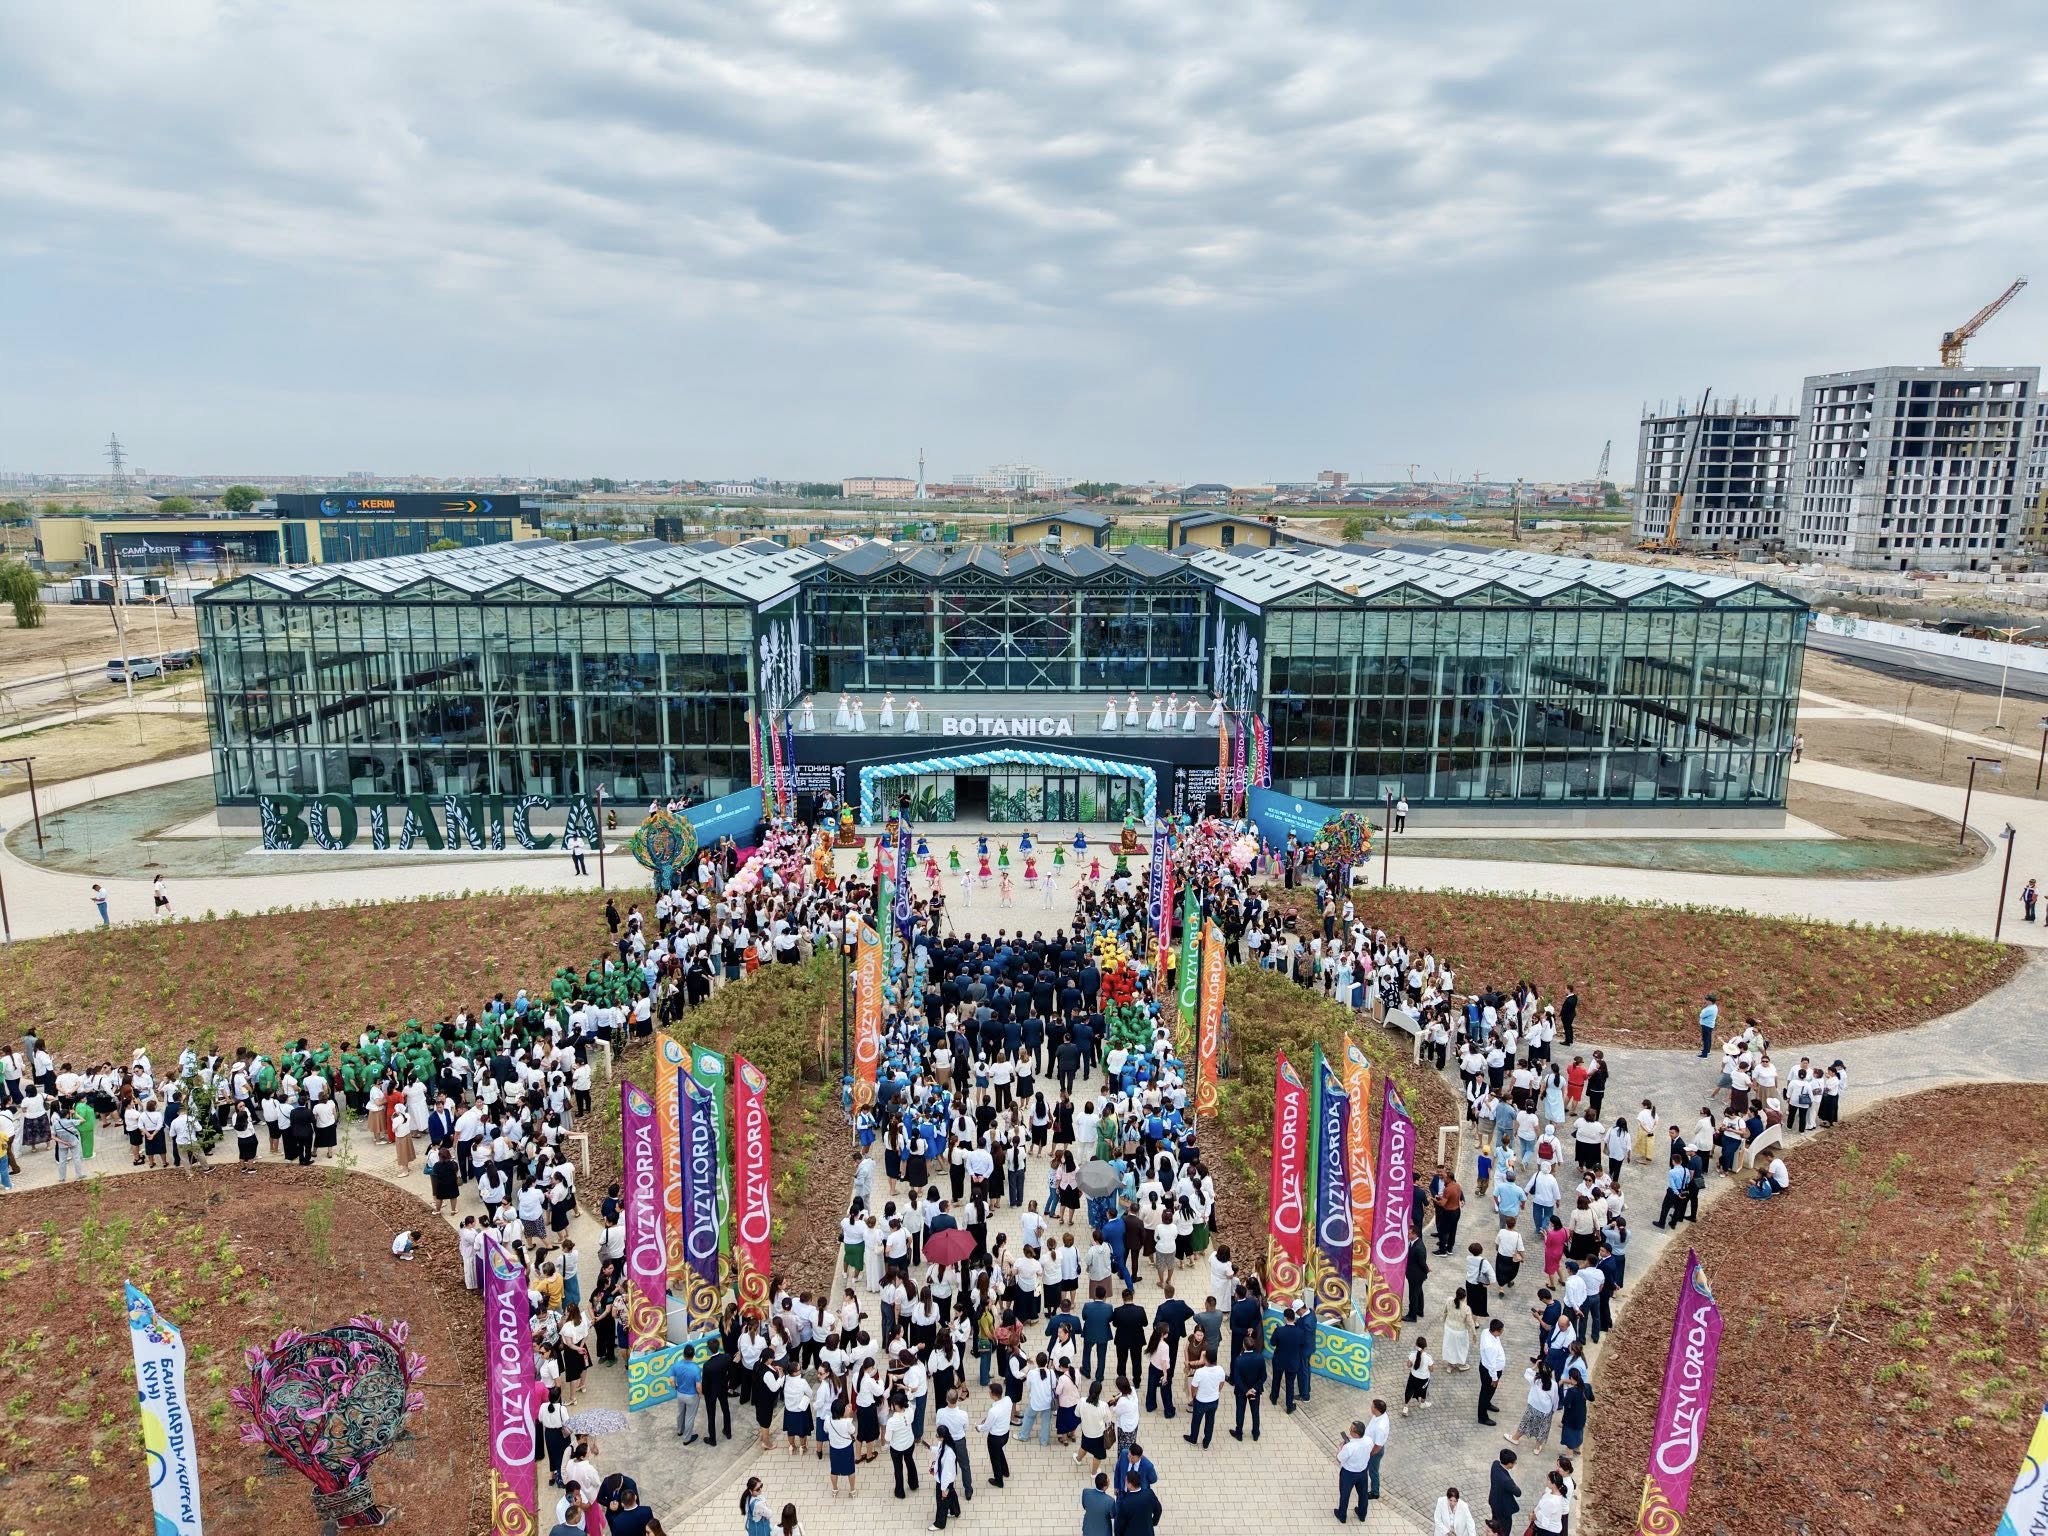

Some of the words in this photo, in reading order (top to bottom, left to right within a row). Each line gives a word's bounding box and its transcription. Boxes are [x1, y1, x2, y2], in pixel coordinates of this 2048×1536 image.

[121, 547, 147, 555] CAMP
[148, 546, 181, 554] CENTER
[942, 717, 1073, 737] BOTANICA
[1204, 777, 1248, 786] АФИА
[1234, 732, 1246, 793] QYZYLORDA
[260, 793, 604, 850] BOTANICA
[896, 836, 910, 921] QYZYLORDA
[1149, 837, 1165, 921] QYZYLORDA
[856, 951, 880, 1063] QYZYLORDA
[1181, 911, 1200, 1008] QYZYLORDA
[1202, 948, 1225, 1059] QYZYLORDA
[631, 1123, 668, 1276] QYZYLORDA
[687, 1109, 721, 1259] QYZYLORDA
[740, 1096, 771, 1244] QYZYLORDA
[1274, 1091, 1303, 1234] QYZYLORDA
[1320, 1101, 1354, 1248] QYZYLORDA
[1375, 1120, 1410, 1265] QYZYLORDA
[495, 1290, 536, 1467] QYZYLORDA
[1656, 1306, 1712, 1475] QYZYLORDA
